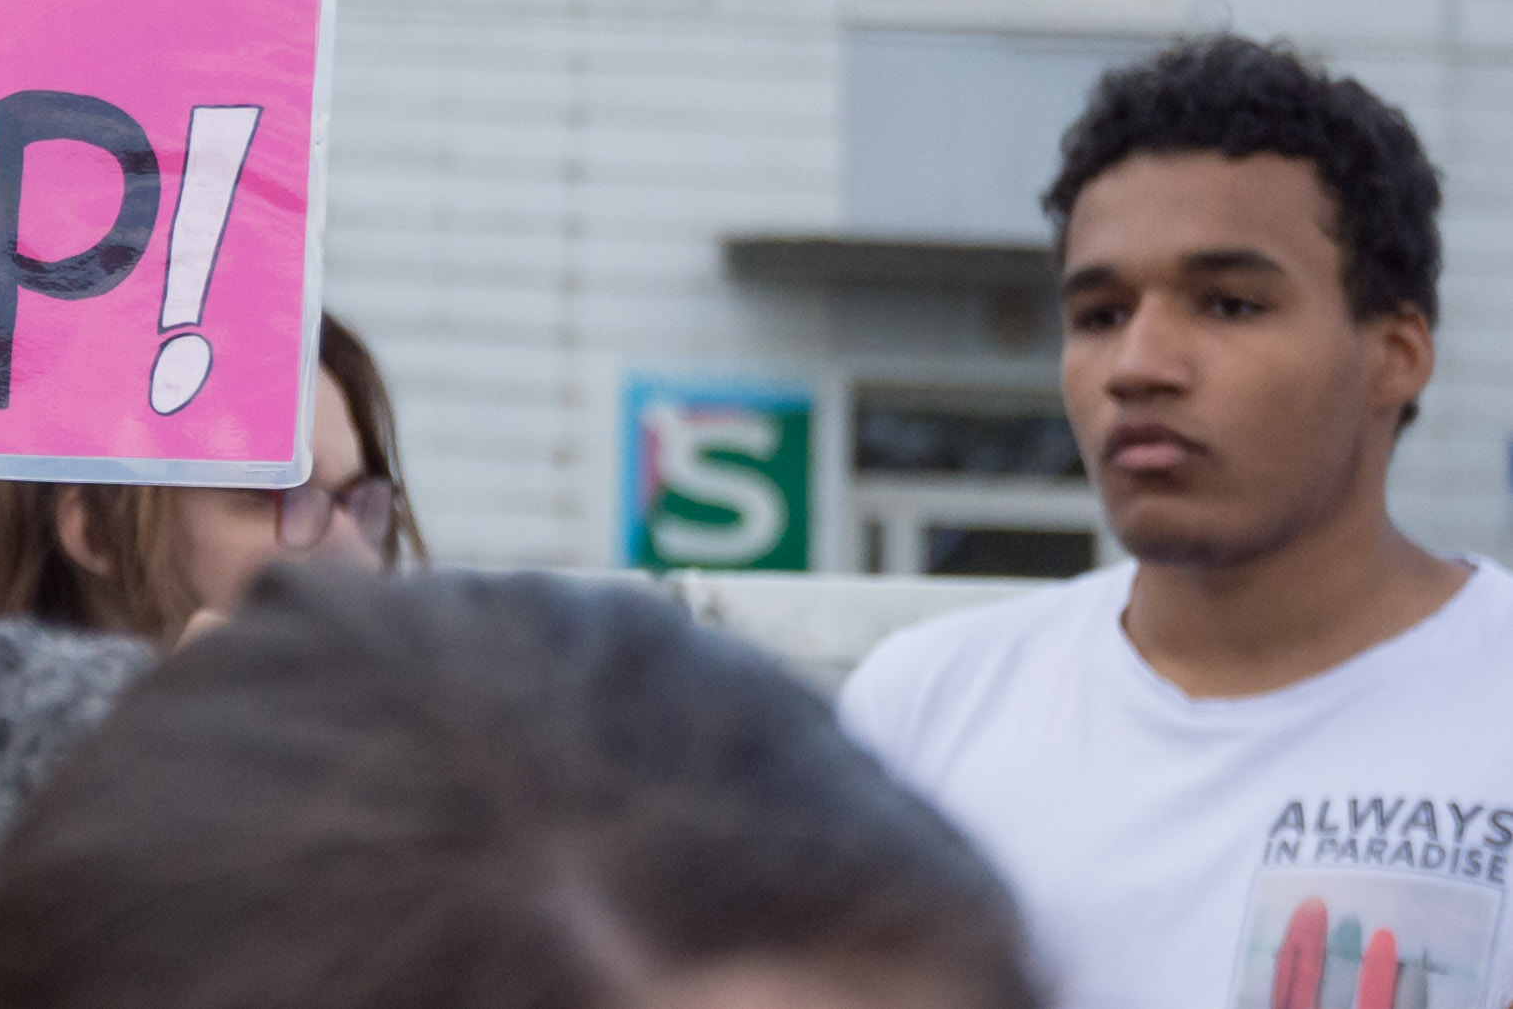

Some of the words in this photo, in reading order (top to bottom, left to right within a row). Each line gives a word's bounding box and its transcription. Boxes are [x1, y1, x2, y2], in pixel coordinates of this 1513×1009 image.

[1267, 797, 1513, 847] ALWAYS
[1262, 840, 1300, 866] IN
[1314, 838, 1508, 886] PARADISE
